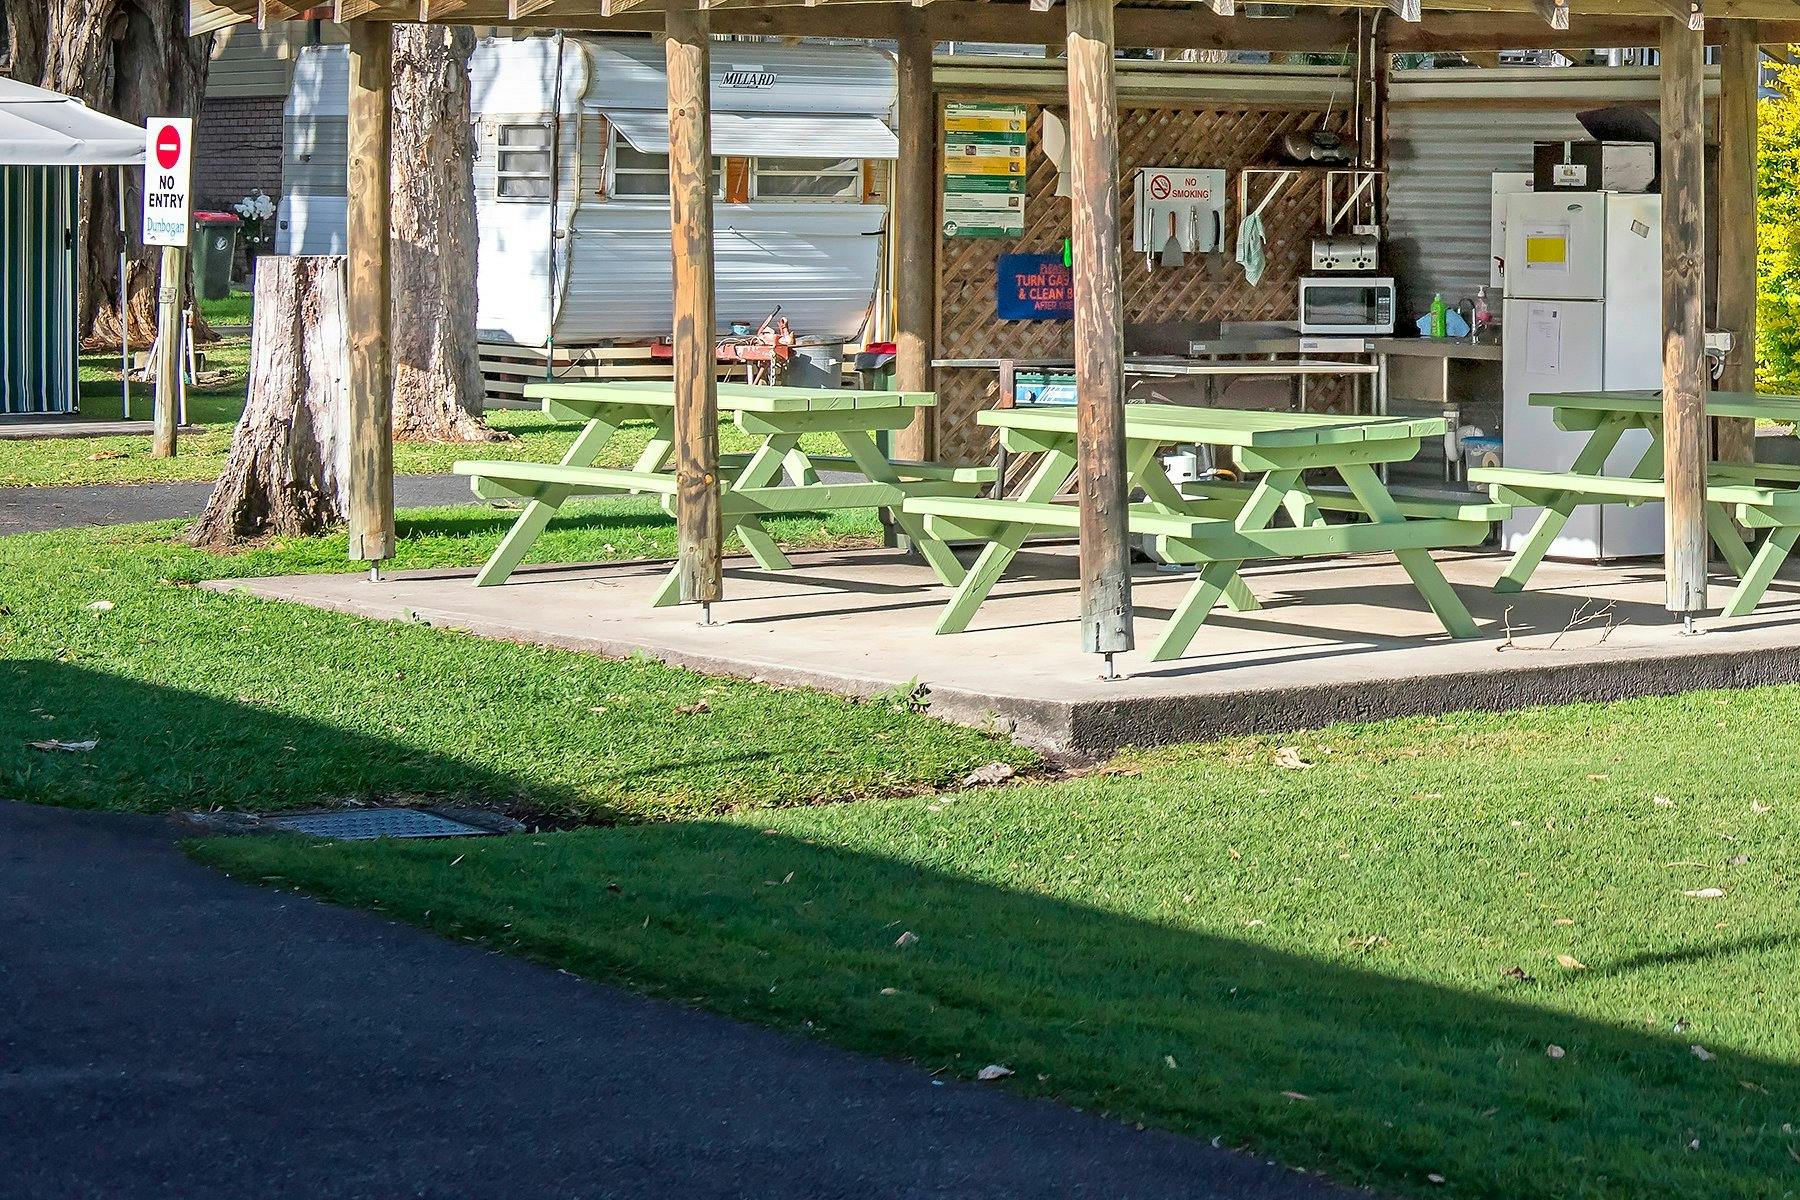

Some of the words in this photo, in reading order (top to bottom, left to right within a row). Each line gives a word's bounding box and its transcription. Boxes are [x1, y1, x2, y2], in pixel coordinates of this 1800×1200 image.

[723, 73, 775, 85] MILLARD
[160, 175, 175, 189] NO
[1185, 178, 1197, 186] NO
[1172, 189, 1209, 198] SMOKING
[149, 193, 184, 208] ENTRY
[147, 217, 184, 237] Dunbogan
[1016, 274, 1045, 287] TURN
[1029, 288, 1064, 300] CLEAN
